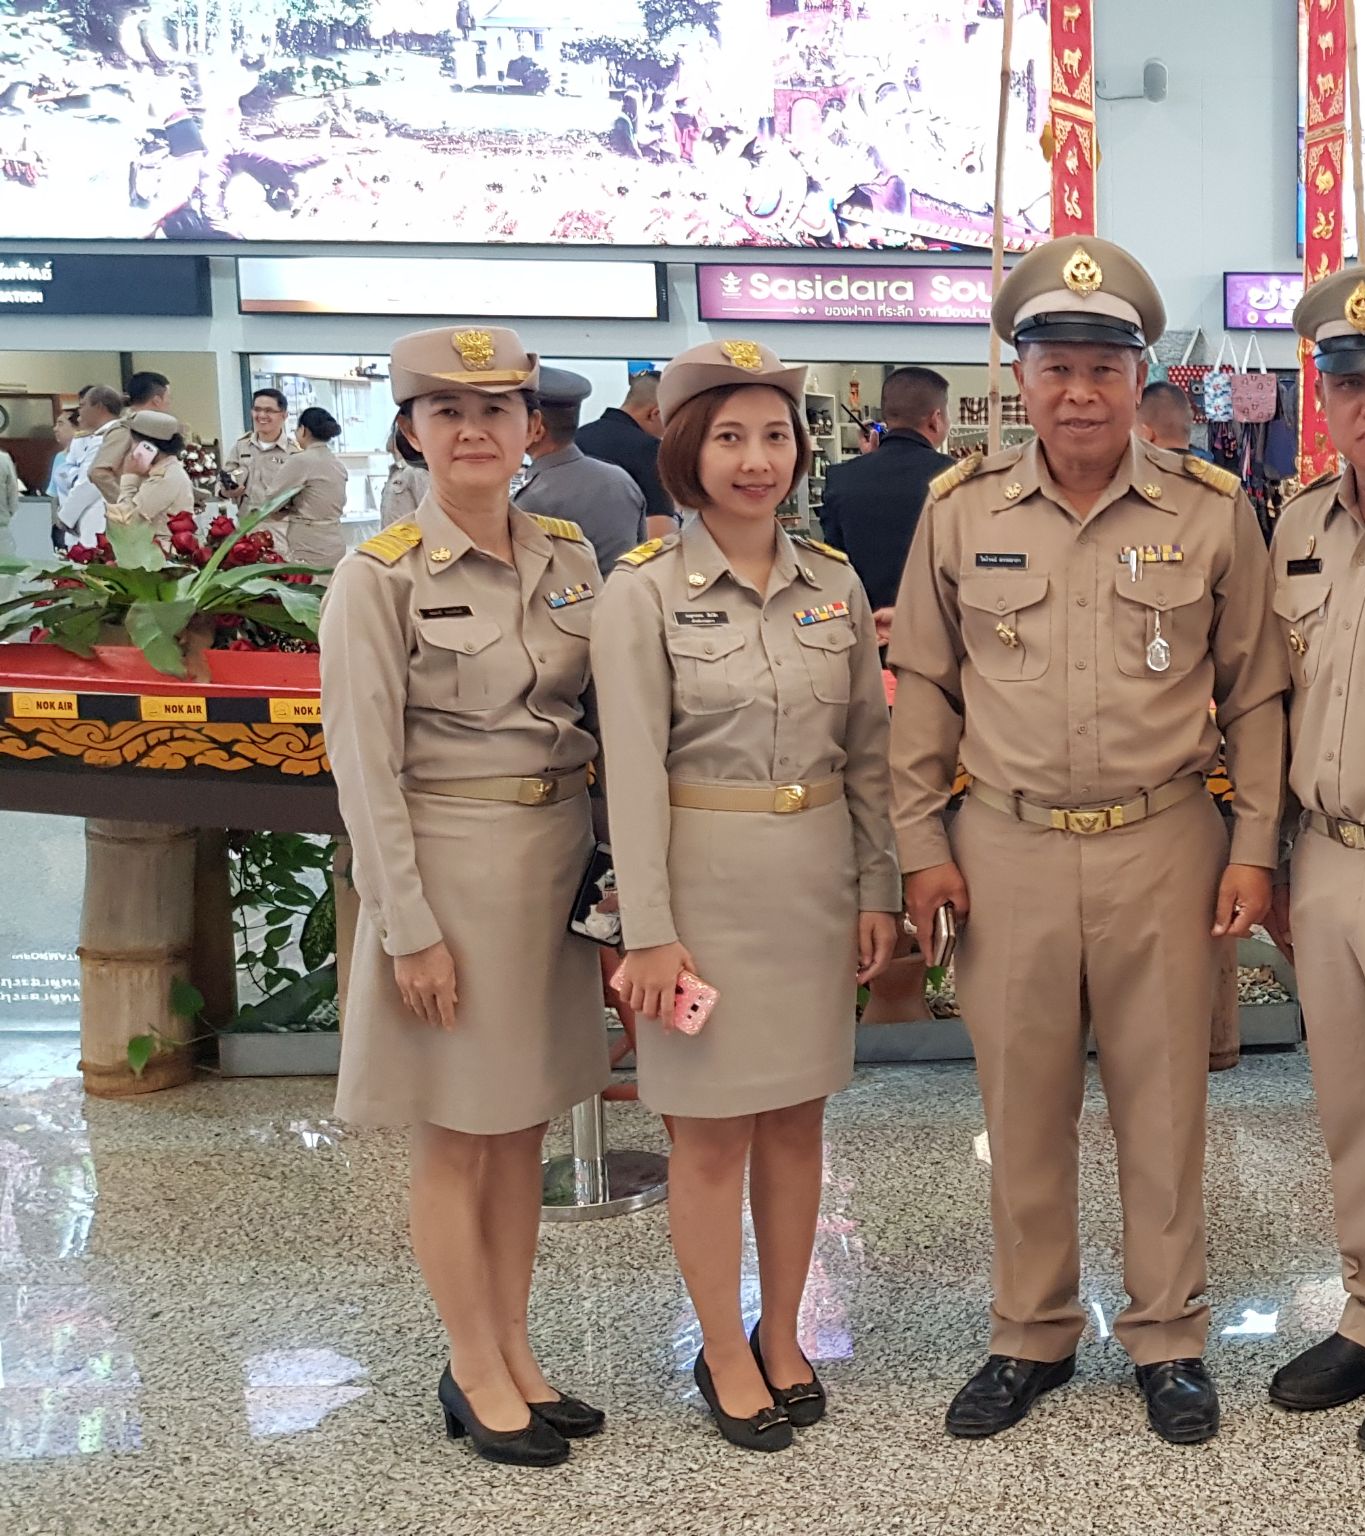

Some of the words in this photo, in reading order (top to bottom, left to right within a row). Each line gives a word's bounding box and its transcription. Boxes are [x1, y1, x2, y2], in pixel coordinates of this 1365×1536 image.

[749, 273, 915, 301] Sasidara
[824, 305, 873, 316] ของฝาก
[878, 303, 913, 317] ที่ระลึก
[36, 700, 56, 710] NOK
[57, 701, 73, 711] AIR
[164, 704, 185, 713] NOK
[186, 704, 202, 714] AIR
[293, 705, 314, 715] NOK
